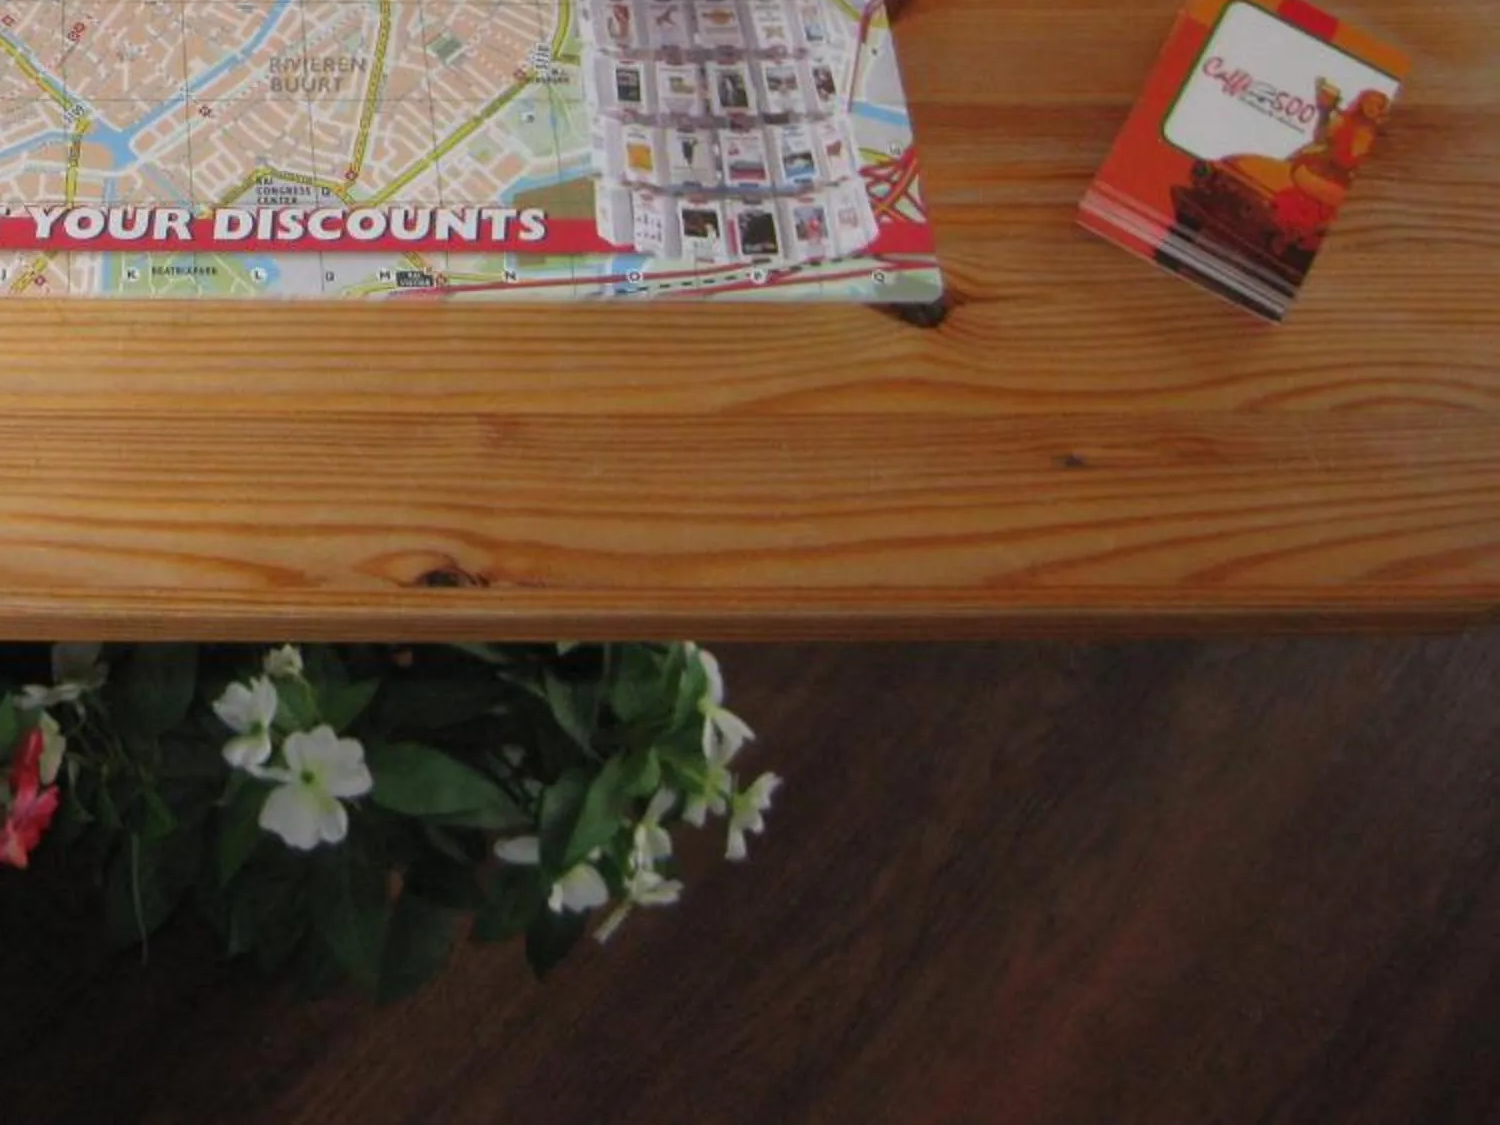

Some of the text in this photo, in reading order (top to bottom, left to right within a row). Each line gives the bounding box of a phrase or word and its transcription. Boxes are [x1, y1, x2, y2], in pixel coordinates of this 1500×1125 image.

[268, 56, 368, 75] RIVIEREN
[268, 75, 345, 94] BUURT
[255, 186, 312, 197] CONGRESS
[255, 195, 298, 206] CENTER
[14, 203, 202, 242] YOUR
[211, 203, 551, 245] DISCOUNTS
